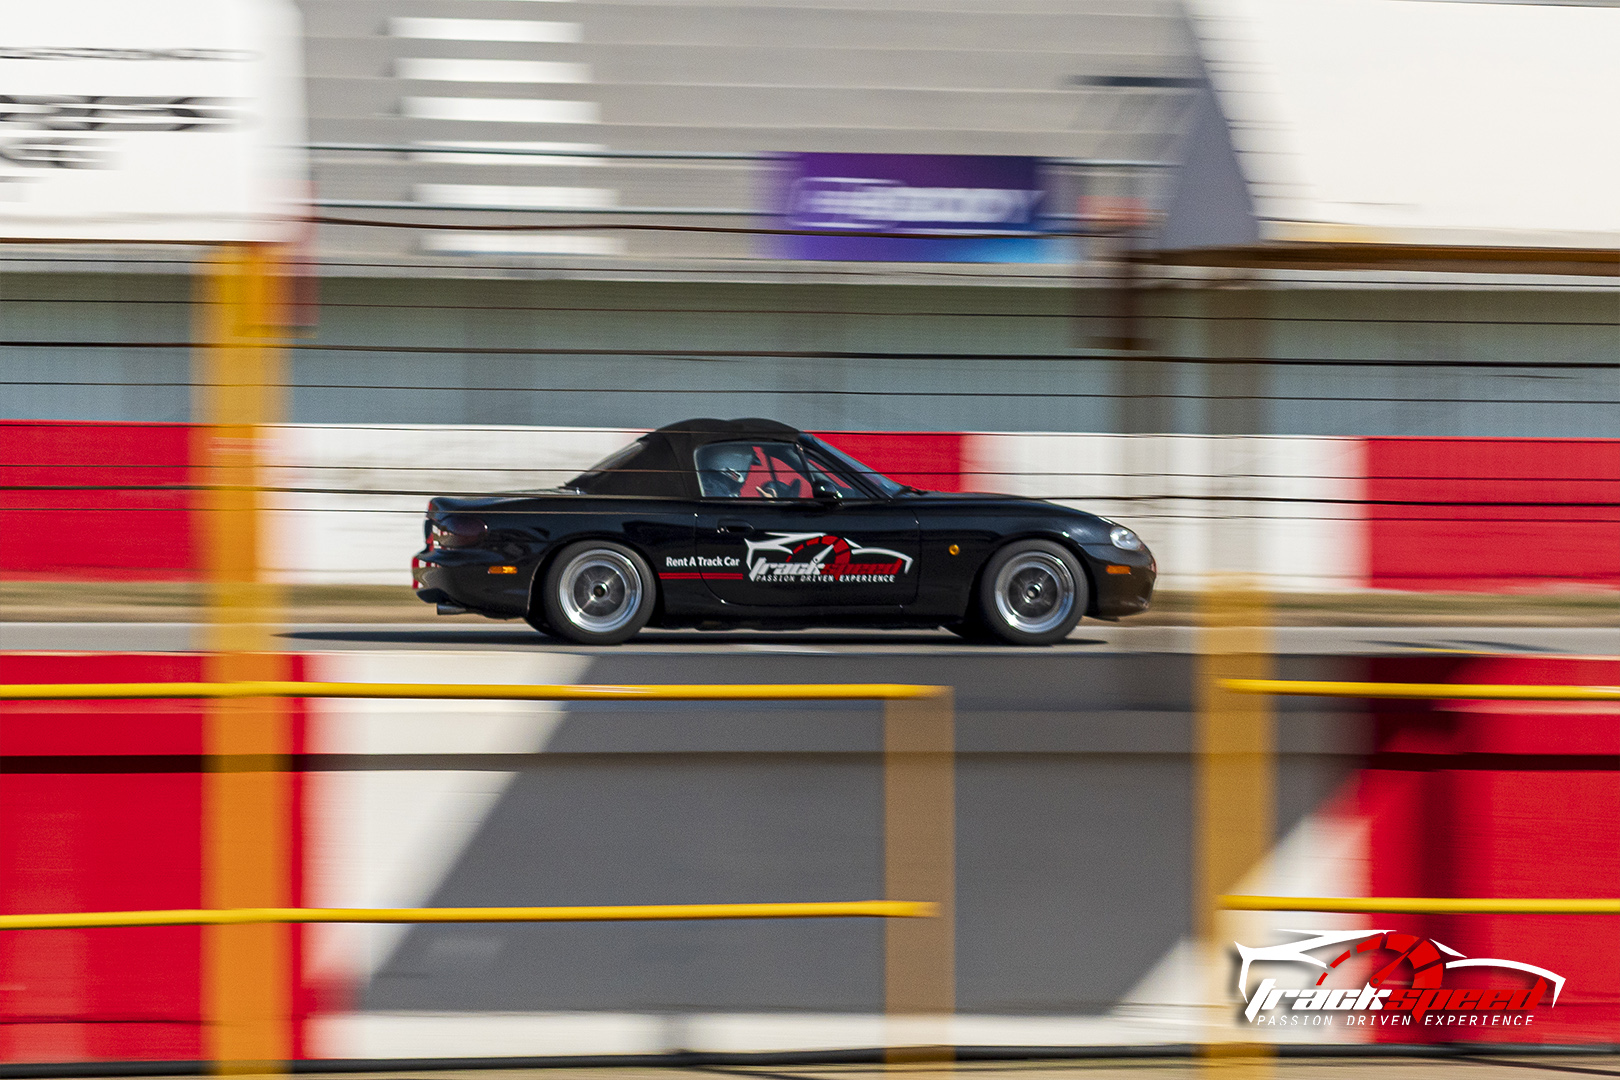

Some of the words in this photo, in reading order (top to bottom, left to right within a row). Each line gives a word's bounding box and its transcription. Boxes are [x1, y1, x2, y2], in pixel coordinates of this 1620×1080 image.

[666, 556, 688, 567] Rent
[689, 557, 697, 567] A
[698, 556, 722, 567] Track
[724, 557, 740, 567] Car
[756, 574, 795, 582] PASSION
[801, 574, 834, 582] DRIVEN
[839, 574, 895, 583] EXPERIENCE
